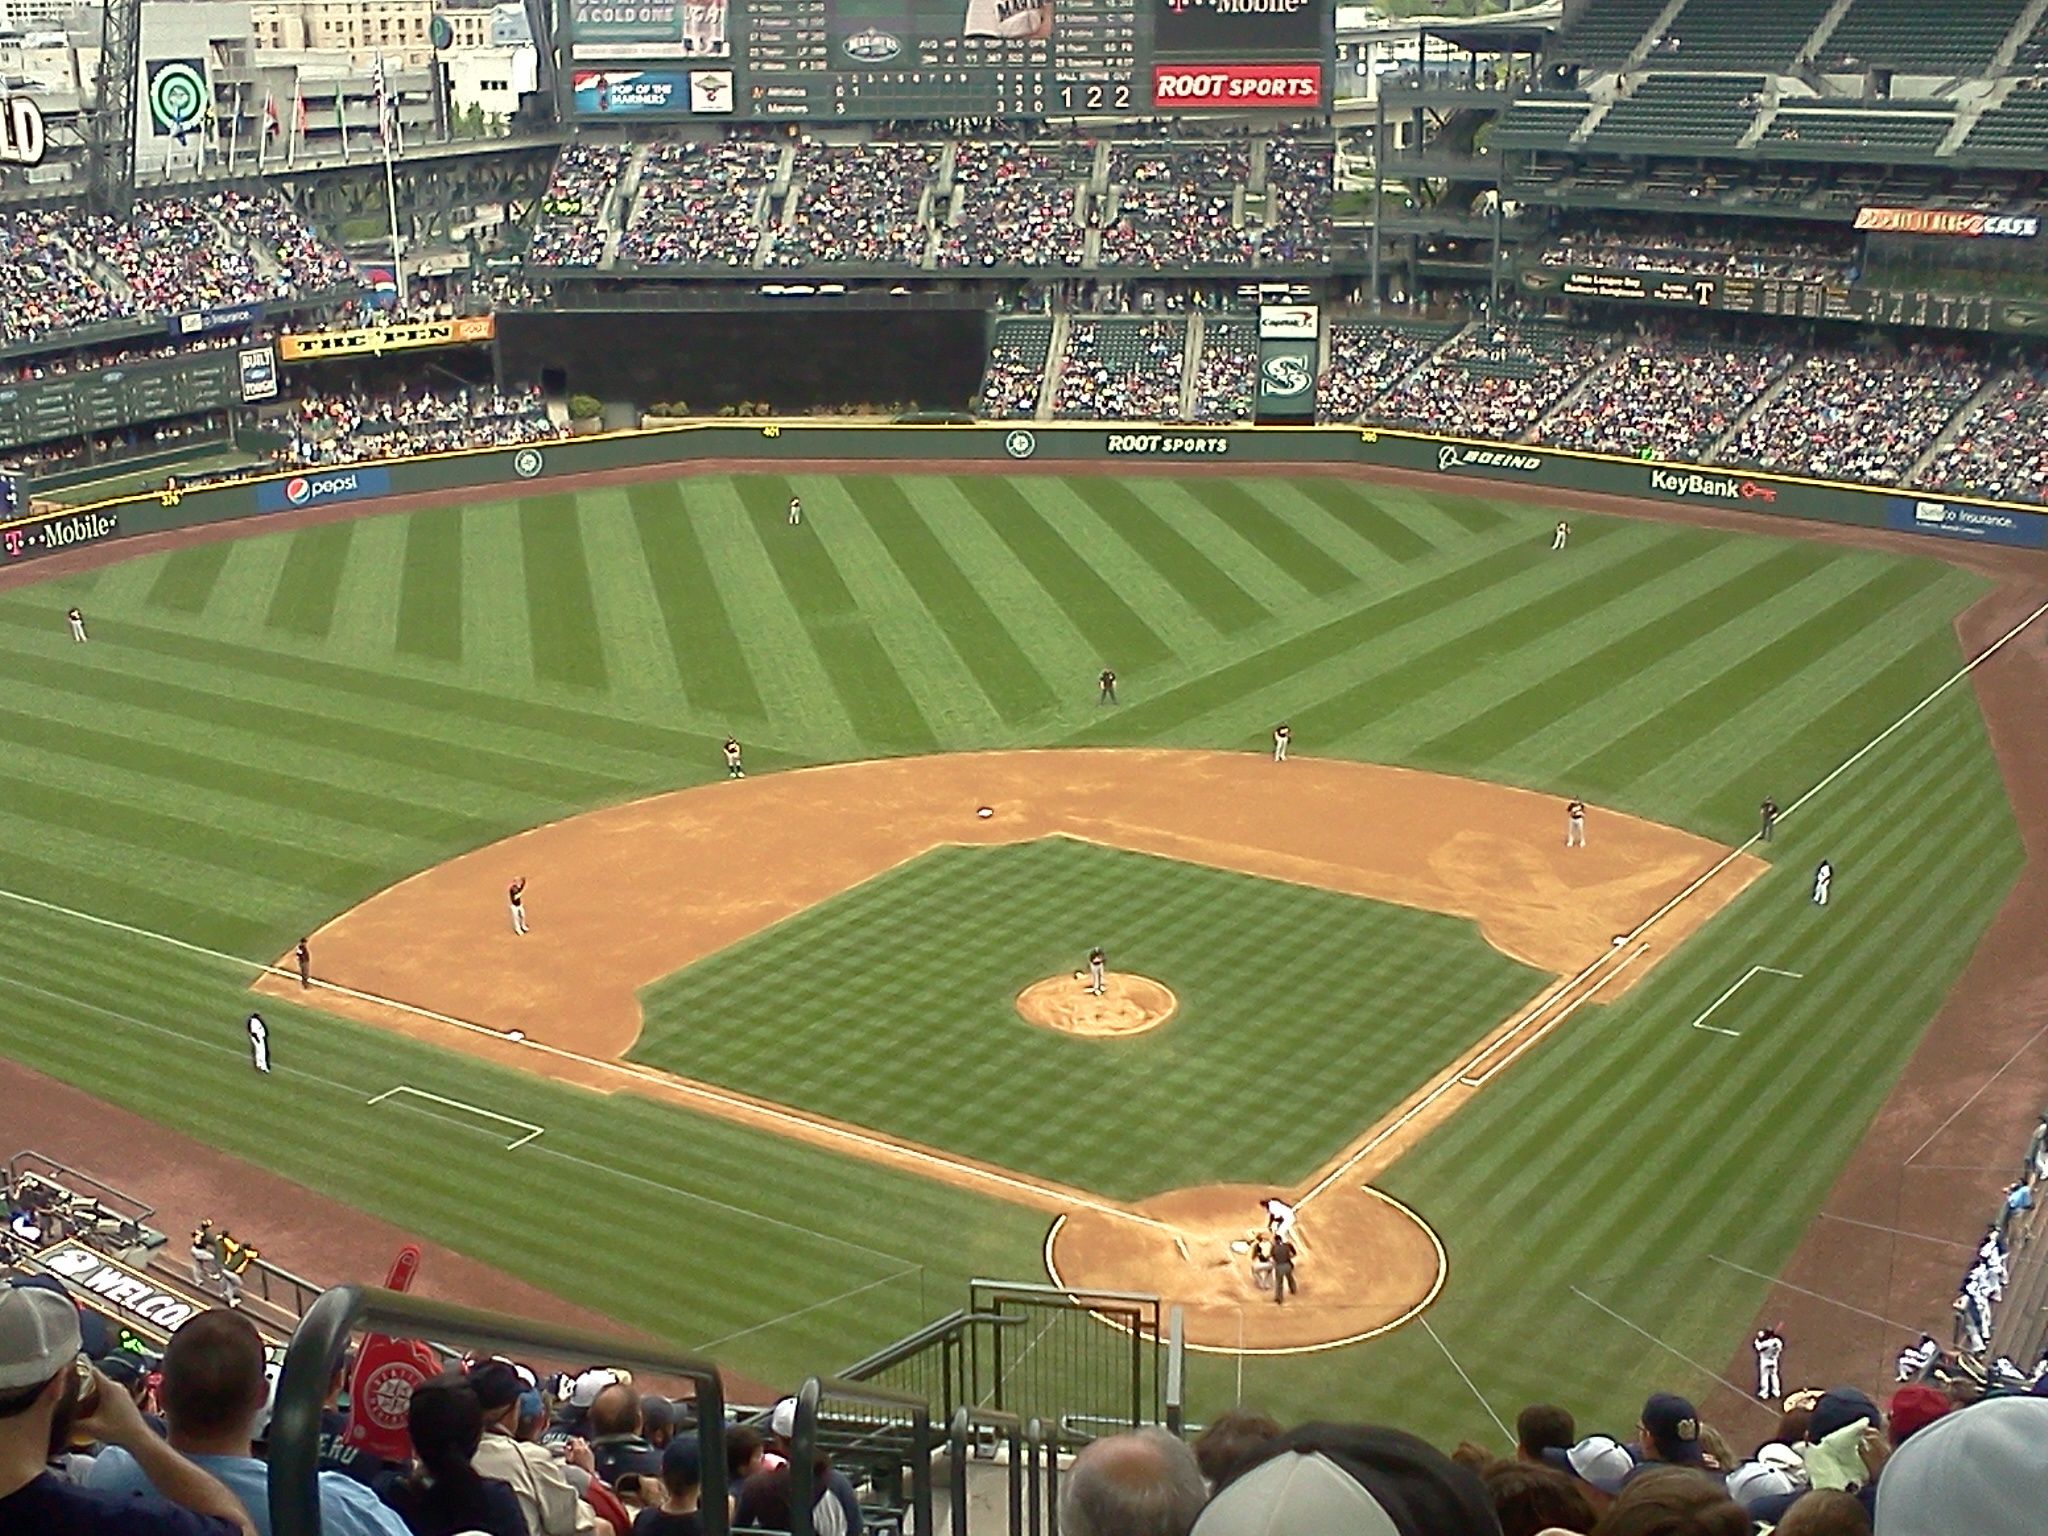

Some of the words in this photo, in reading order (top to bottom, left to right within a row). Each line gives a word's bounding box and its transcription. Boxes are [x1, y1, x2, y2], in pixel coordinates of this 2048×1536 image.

[591, 8, 636, 22] COLD
[638, 8, 674, 22] ONE
[651, 84, 672, 94] THE
[1061, 86, 1071, 108] 1
[1087, 86, 1103, 108] 2
[1115, 86, 1130, 108] 2
[1158, 75, 1229, 97] ROOT
[1229, 78, 1314, 97] SPORTS
[1694, 282, 1714, 305] T
[297, 333, 367, 352] THE
[242, 350, 271, 370] BUILT
[1108, 435, 1161, 452] ROOT
[1163, 438, 1228, 453] SPORTS
[1462, 450, 1542, 470] BOEING
[311, 474, 359, 498] pepsi
[1651, 470, 1740, 498] KeyBank
[44, 513, 110, 548] Mobile
[84, 1266, 191, 1331] WELCO
